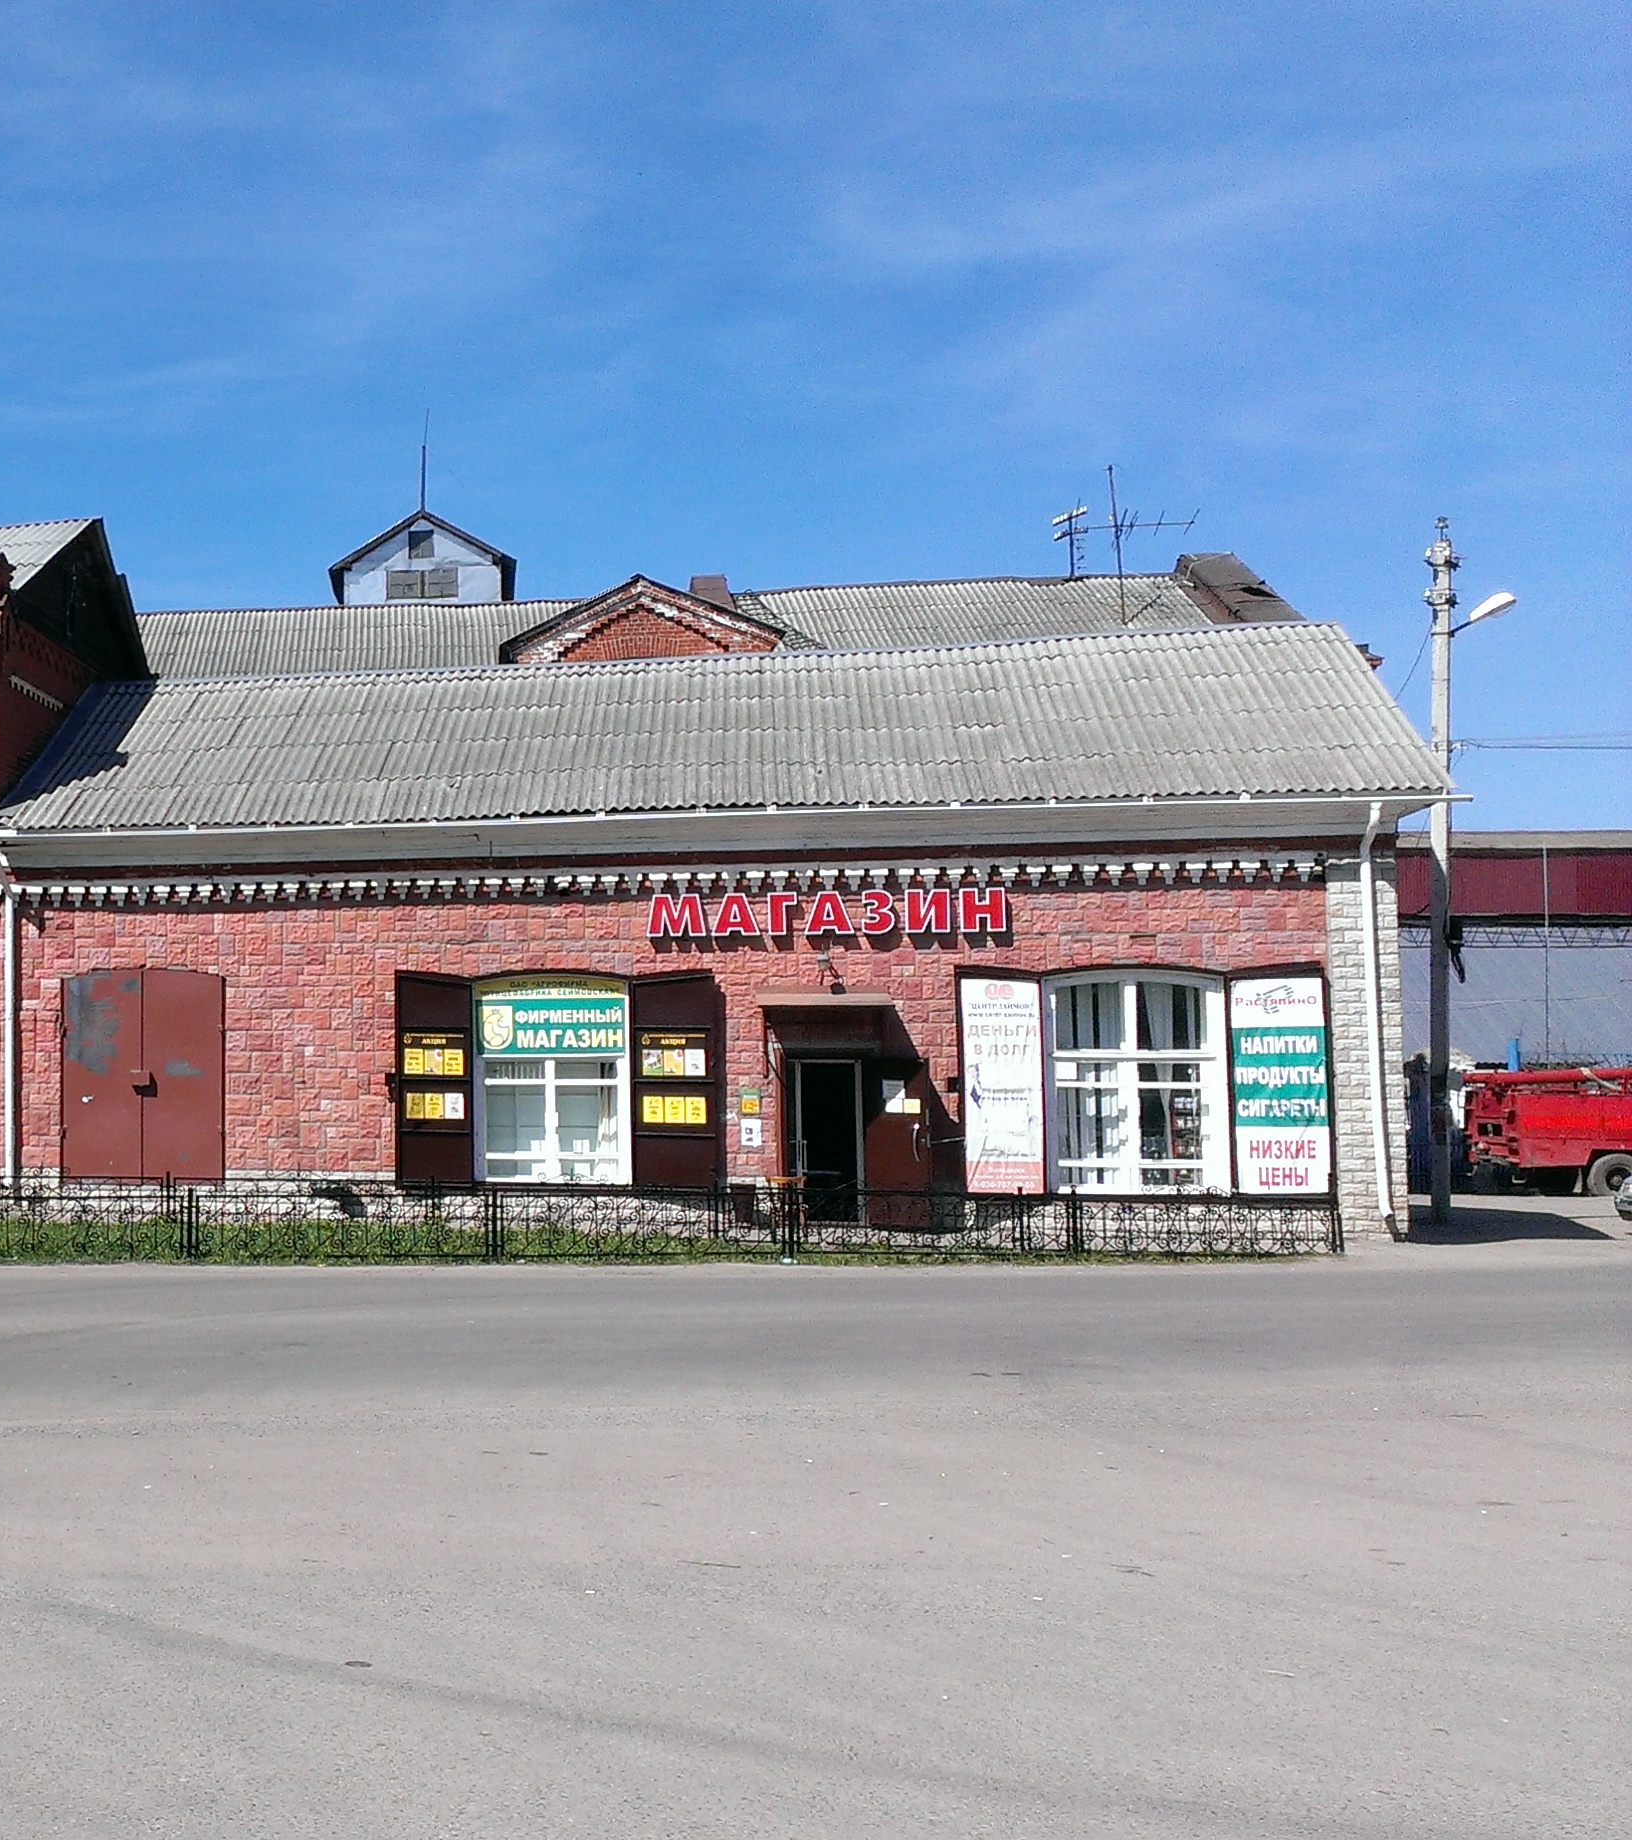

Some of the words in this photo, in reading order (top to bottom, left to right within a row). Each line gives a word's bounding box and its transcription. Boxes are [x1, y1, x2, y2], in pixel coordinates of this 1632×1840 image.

[647, 886, 1008, 938] МАГАЗИН
[515, 1006, 622, 1024] ФИРМЕННЫЙ
[516, 1029, 624, 1048] МАГАЗИН
[967, 1024, 1037, 1038] ДЕНЬГИ
[988, 1044, 1030, 1057] ДОЛГ
[1240, 1035, 1318, 1054] НАПИТКИ
[1236, 1065, 1325, 1087] ПРОДУКТЫ
[1237, 1097, 1327, 1119] СИГАРЕТЫ
[1249, 1139, 1317, 1160] НИЗКИЕ
[1258, 1167, 1309, 1191] ЦЕНЫ
